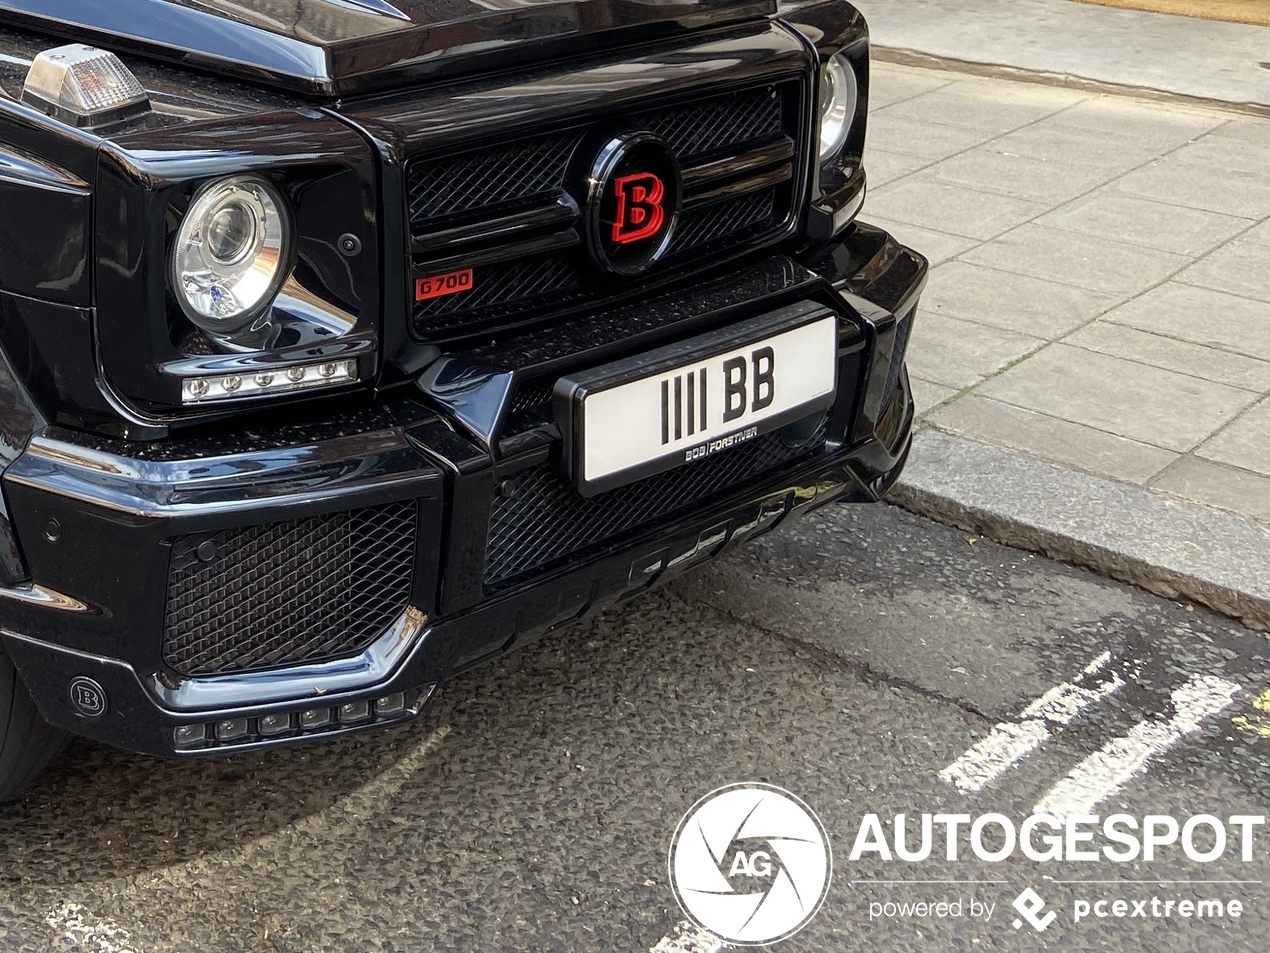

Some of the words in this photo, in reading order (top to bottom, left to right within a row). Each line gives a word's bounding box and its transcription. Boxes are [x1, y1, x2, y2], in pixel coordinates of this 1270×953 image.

[612, 172, 664, 244] B
[420, 281, 432, 295] G
[435, 272, 469, 292] 700
[722, 345, 775, 424] BB
[77, 686, 99, 710] B
